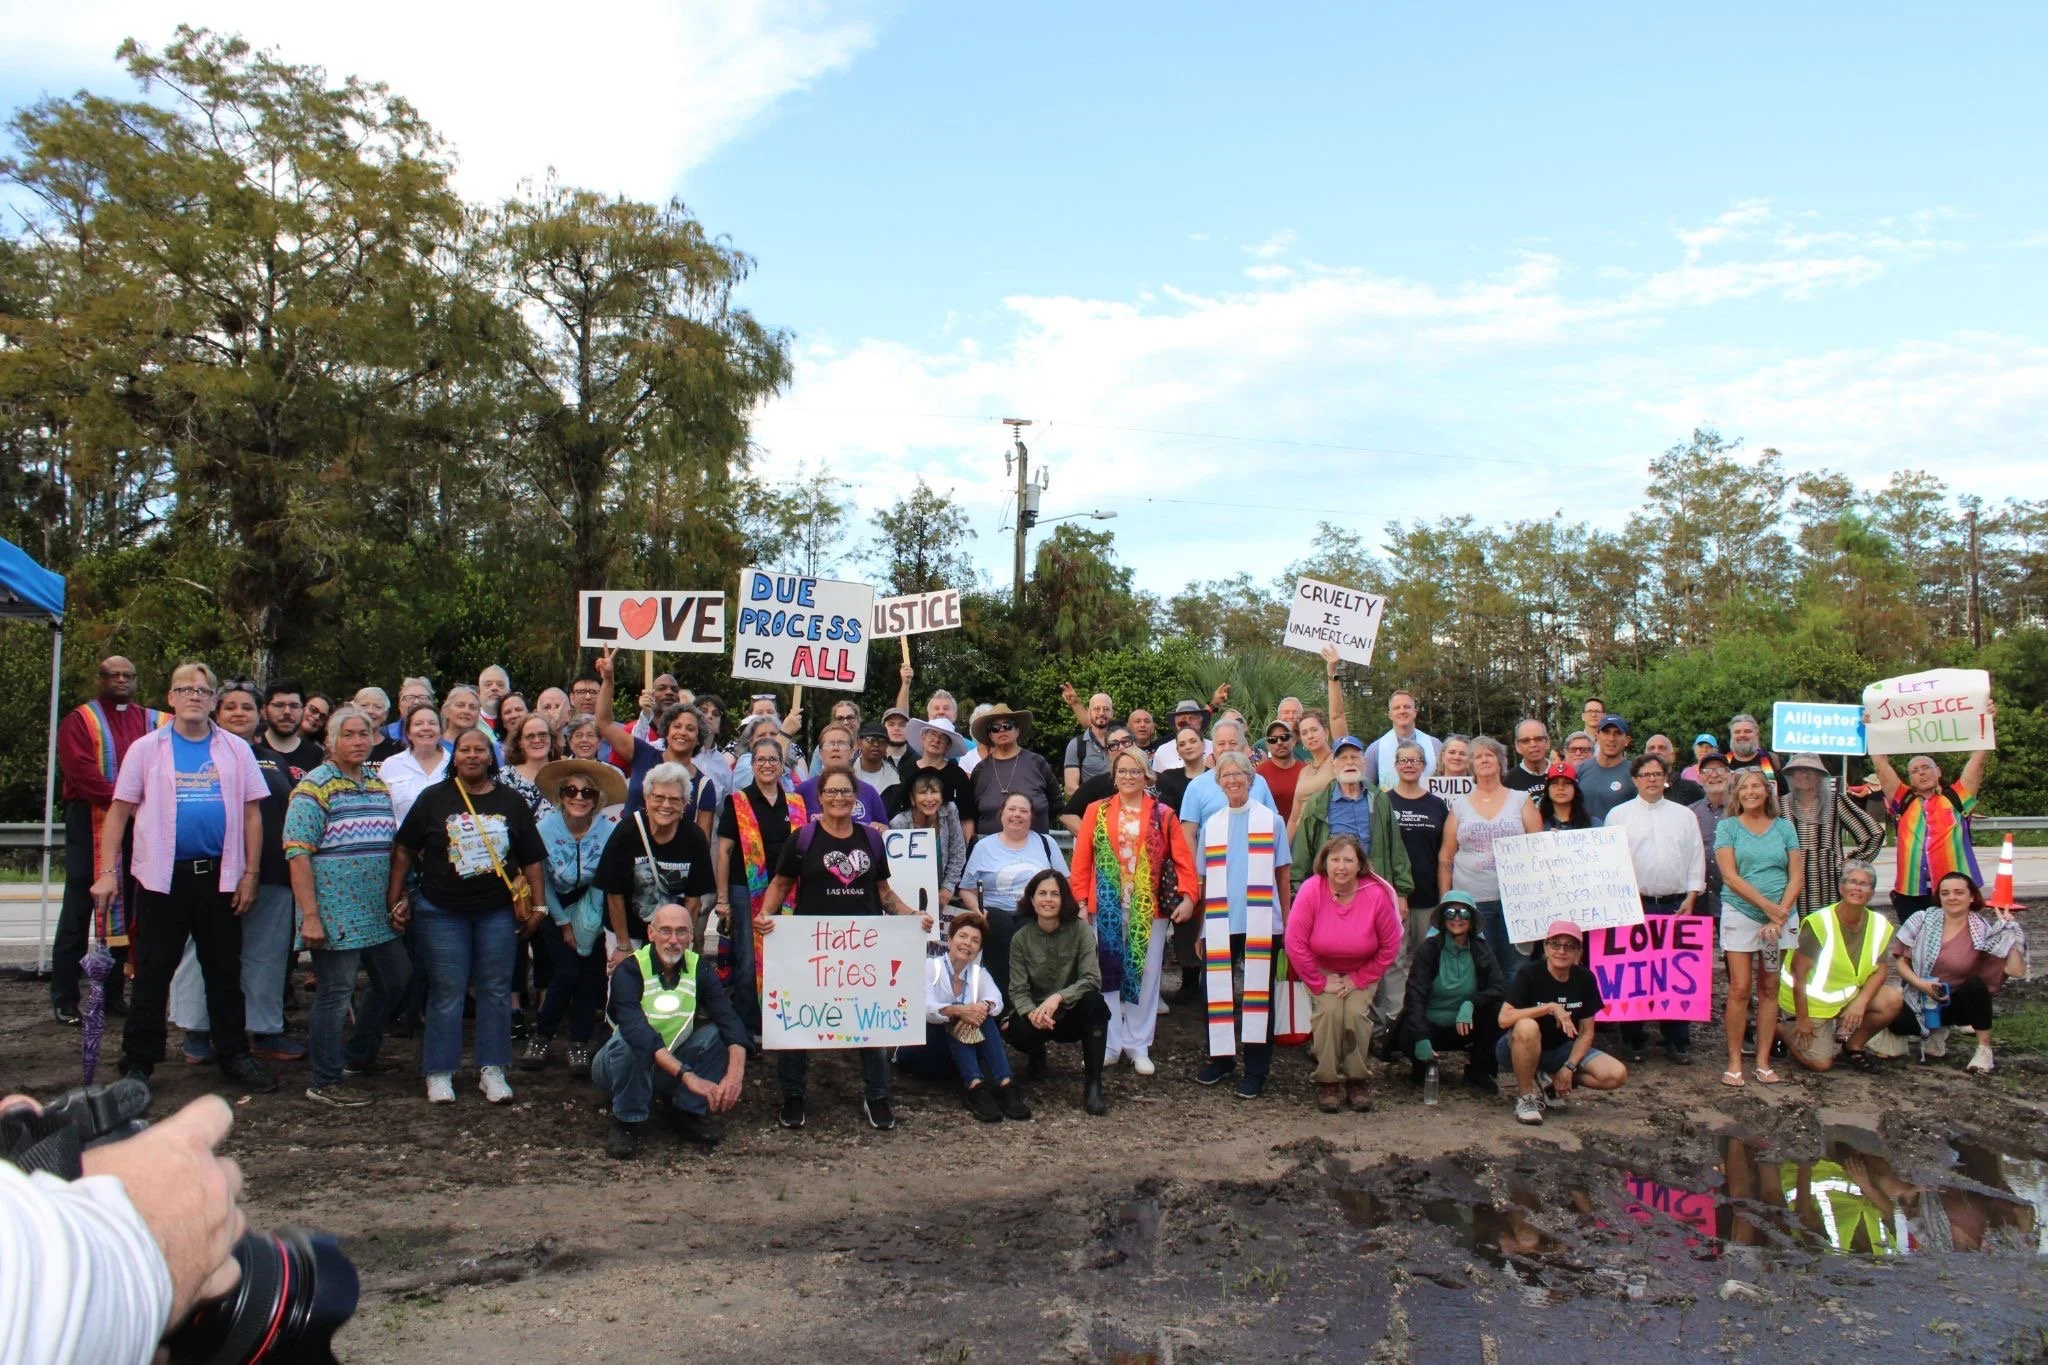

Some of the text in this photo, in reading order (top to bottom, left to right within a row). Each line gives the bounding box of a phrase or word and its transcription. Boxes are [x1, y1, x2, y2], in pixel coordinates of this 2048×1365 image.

[751, 573, 817, 608] DUE
[1300, 584, 1378, 617] CRUELTY
[739, 608, 862, 643] PROCESS
[874, 594, 960, 635] USTICE
[1323, 612, 1340, 626] IS
[1289, 622, 1373, 649] UNAMERICAN!
[791, 645, 856, 683] ALL
[1898, 679, 1940, 694] LET
[1783, 711, 1860, 727] Alligator
[1877, 697, 1974, 721] JUSTICE
[1783, 731, 1857, 747] Alcatraz
[1907, 717, 1970, 744] ROLL
[1429, 778, 1473, 795] BUILD
[826, 888, 865, 896] LAS VEGAS
[811, 921, 878, 951] Hate
[1603, 919, 1704, 956] LOVE
[808, 955, 877, 988] Tries
[1595, 951, 1700, 1000] WINS
[779, 999, 843, 1031] Love
